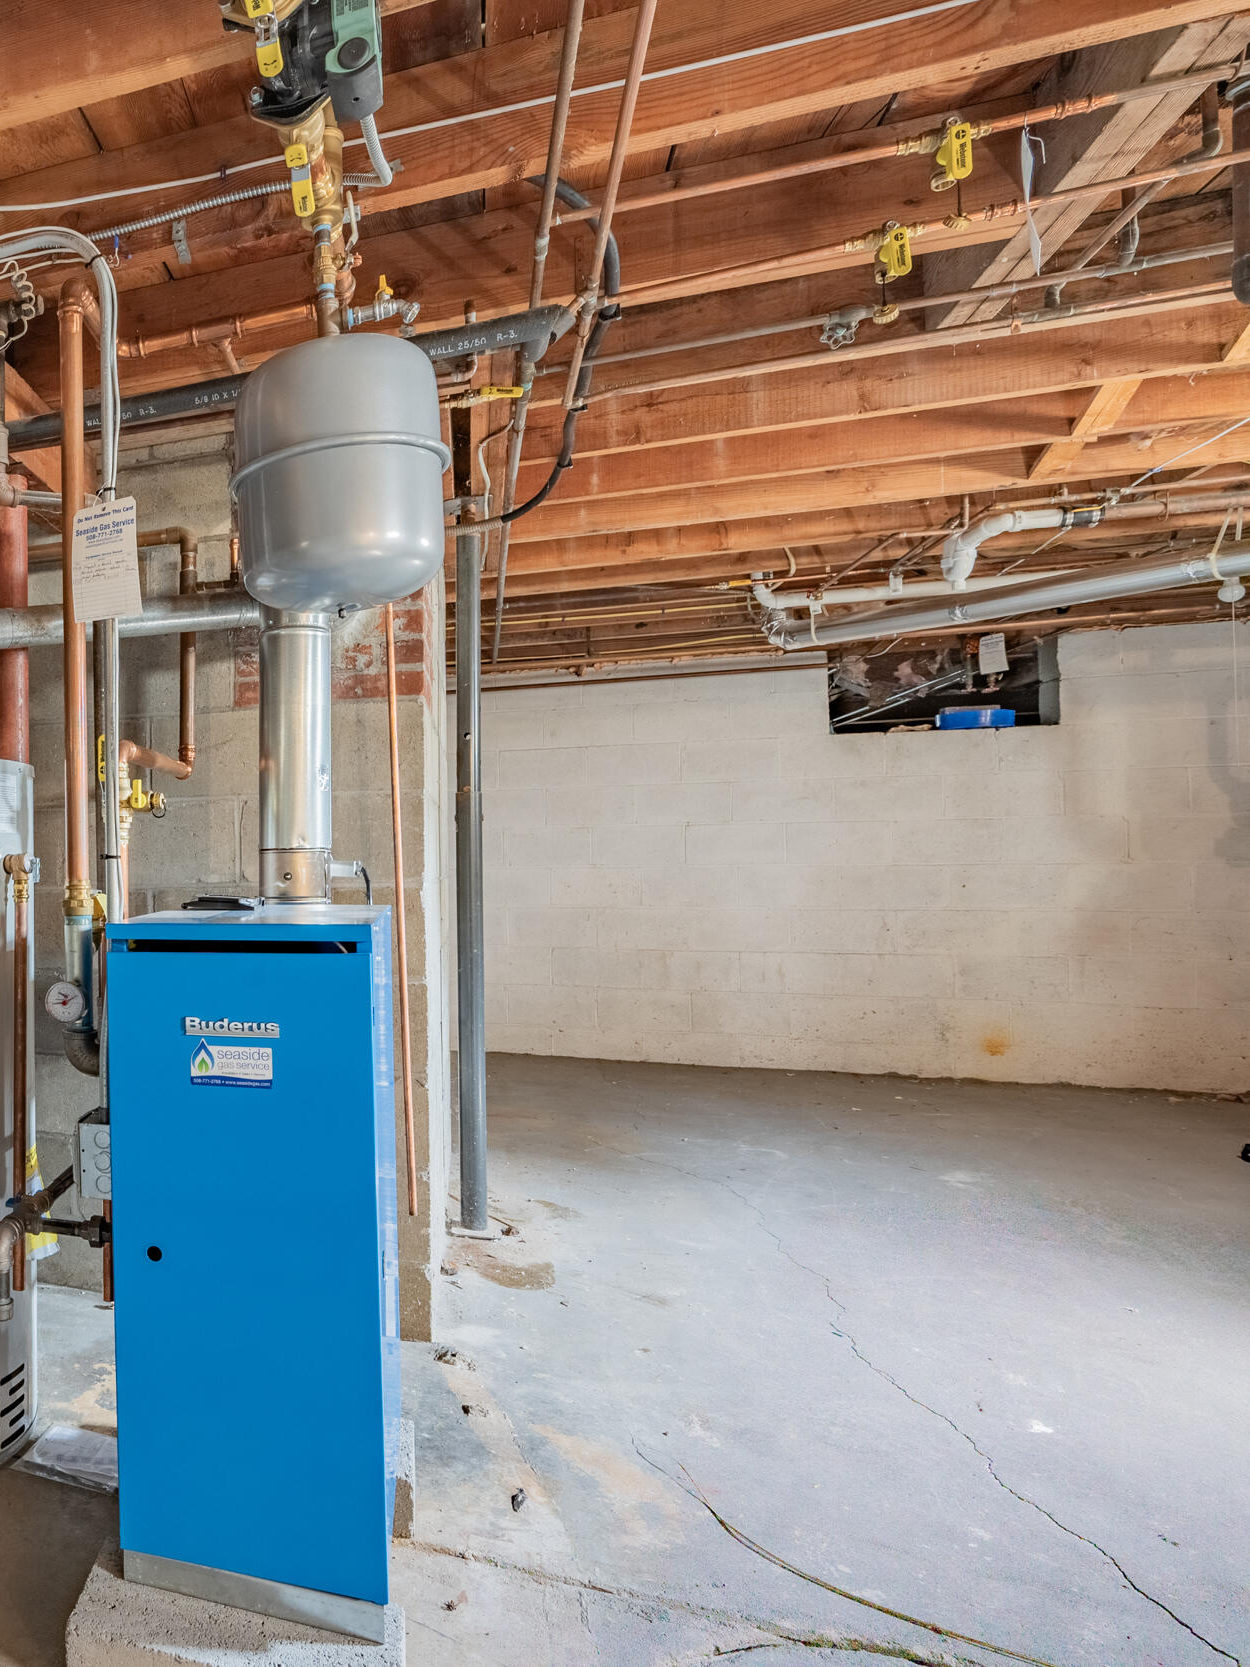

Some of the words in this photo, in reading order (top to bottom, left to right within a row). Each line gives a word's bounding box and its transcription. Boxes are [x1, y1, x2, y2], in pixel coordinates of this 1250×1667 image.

[429, 346, 453, 357] WALL
[457, 337, 486, 351] 25/50
[86, 418, 101, 427] WAL
[75, 526, 98, 537] Seaside
[99, 523, 111, 531] Gas
[111, 518, 135, 528] Service
[185, 1016, 279, 1034] Buderus
[217, 1048, 270, 1061] seaside
[217, 1061, 235, 1071] gas
[236, 1061, 270, 1071] service
